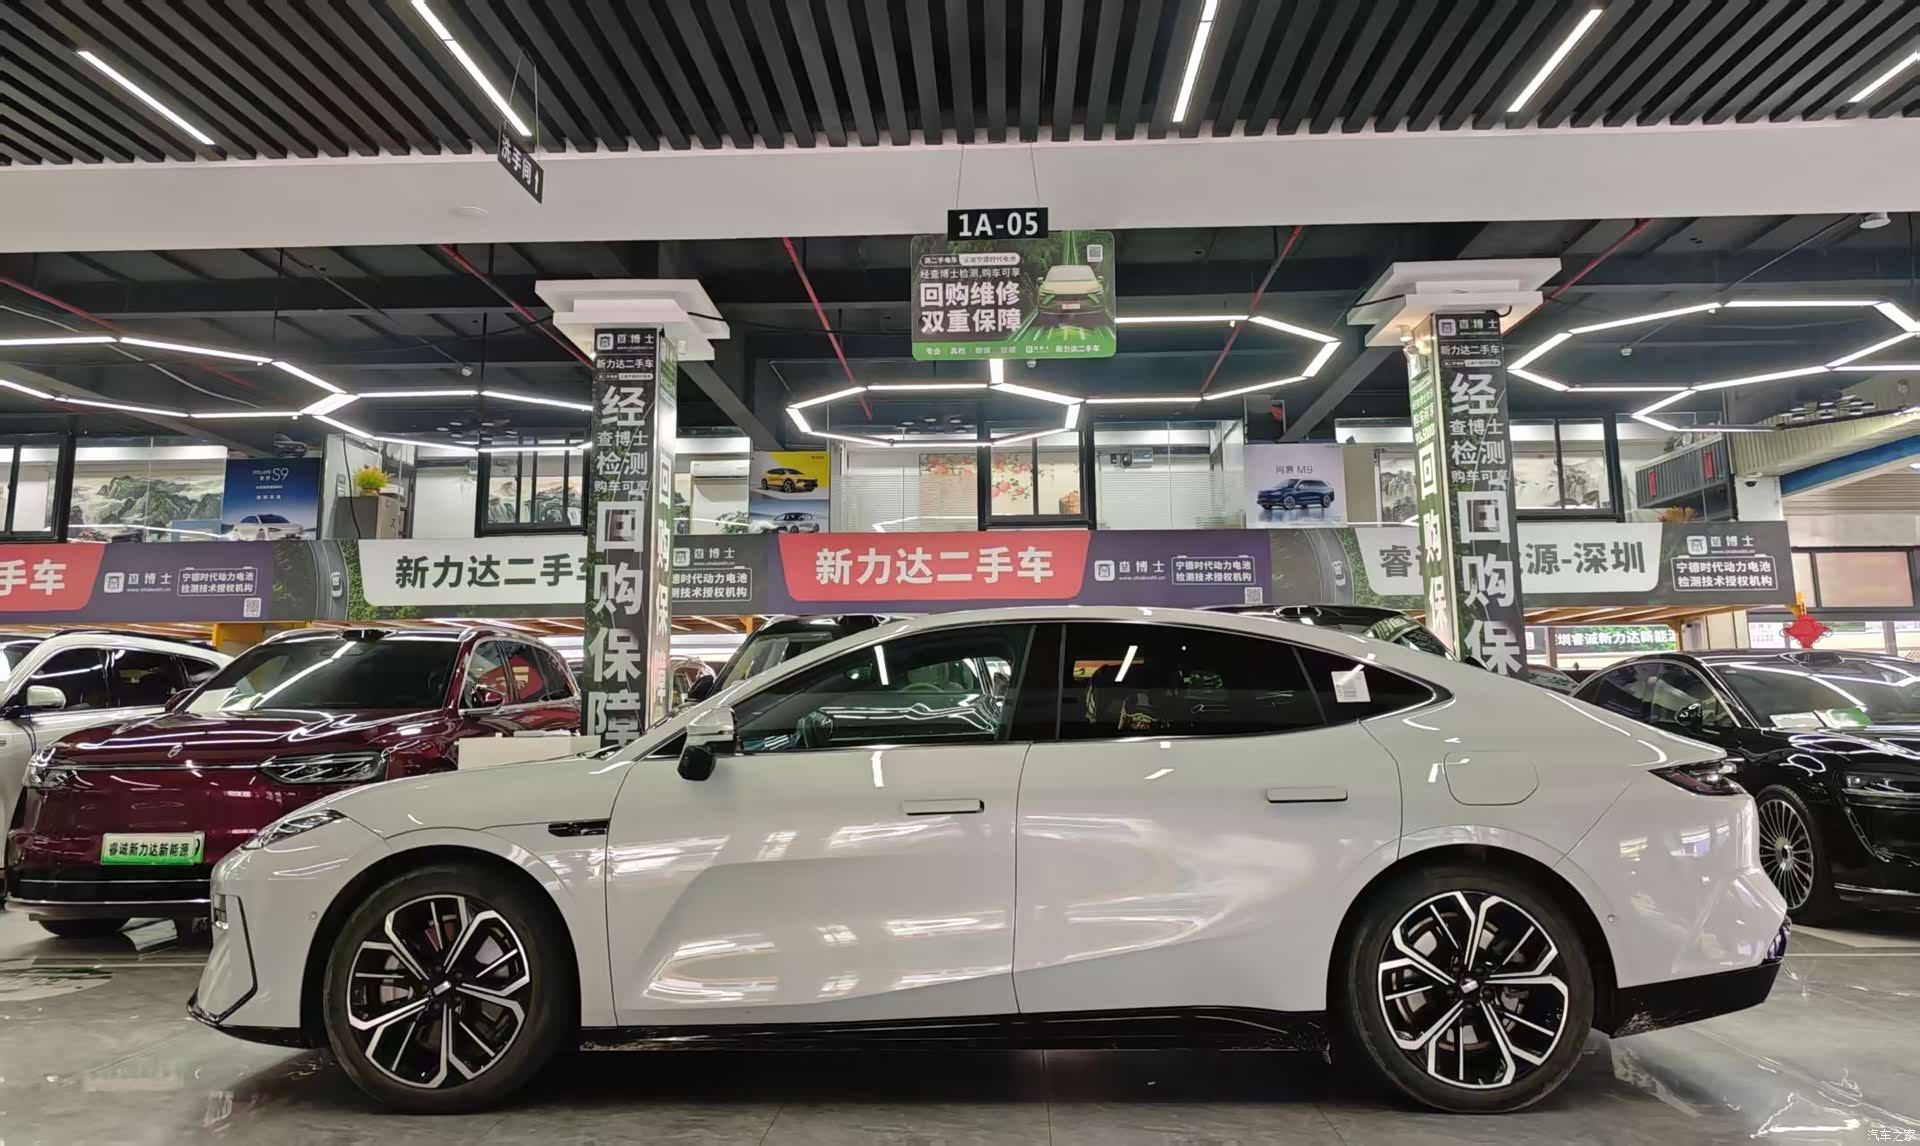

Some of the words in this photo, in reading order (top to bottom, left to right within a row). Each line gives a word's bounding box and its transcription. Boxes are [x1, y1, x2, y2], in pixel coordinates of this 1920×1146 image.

[502, 134, 532, 185] 洗手间
[958, 212, 1039, 238] 1A-05
[920, 281, 1020, 307] 回购维修
[921, 308, 1021, 334] 双重保障
[1459, 318, 1499, 329] 查博士
[616, 333, 655, 344] 查博士
[1440, 344, 1501, 355] 新力达二手车
[596, 358, 654, 369] 新力达二手车
[1450, 372, 1499, 415] 经
[601, 385, 646, 427] 经
[1449, 418, 1504, 436] 查博士
[597, 430, 649, 447] 查博士
[1451, 440, 1506, 465] 检测
[596, 451, 648, 476] 检测
[1297, 465, 1313, 474] M9
[272, 467, 289, 481] S9
[1451, 469, 1510, 484] 购车可享
[593, 479, 649, 493] 购车可享
[1710, 535, 1755, 547] 查博士
[694, 547, 736, 559] 查博士
[1519, 541, 1645, 575] 源-深圳
[815, 546, 1054, 585] 新力达二手车
[1119, 560, 1165, 573] 查博士
[1175, 561, 1251, 570] 宁德时代动力电池
[1676, 561, 1771, 573] 宁德时代动力电池
[127, 572, 172, 585] 查博士
[182, 571, 254, 582] 宁德时代动力电池
[1175, 572, 1251, 582] 检测技术授权机构
[1678, 575, 1773, 587] 检测技术授权机构
[181, 583, 253, 593] 检测技术授权机构
[1555, 630, 1675, 646] 圳睿诚新力达新能
[109, 842, 190, 857] 睿诚新力达新能源
